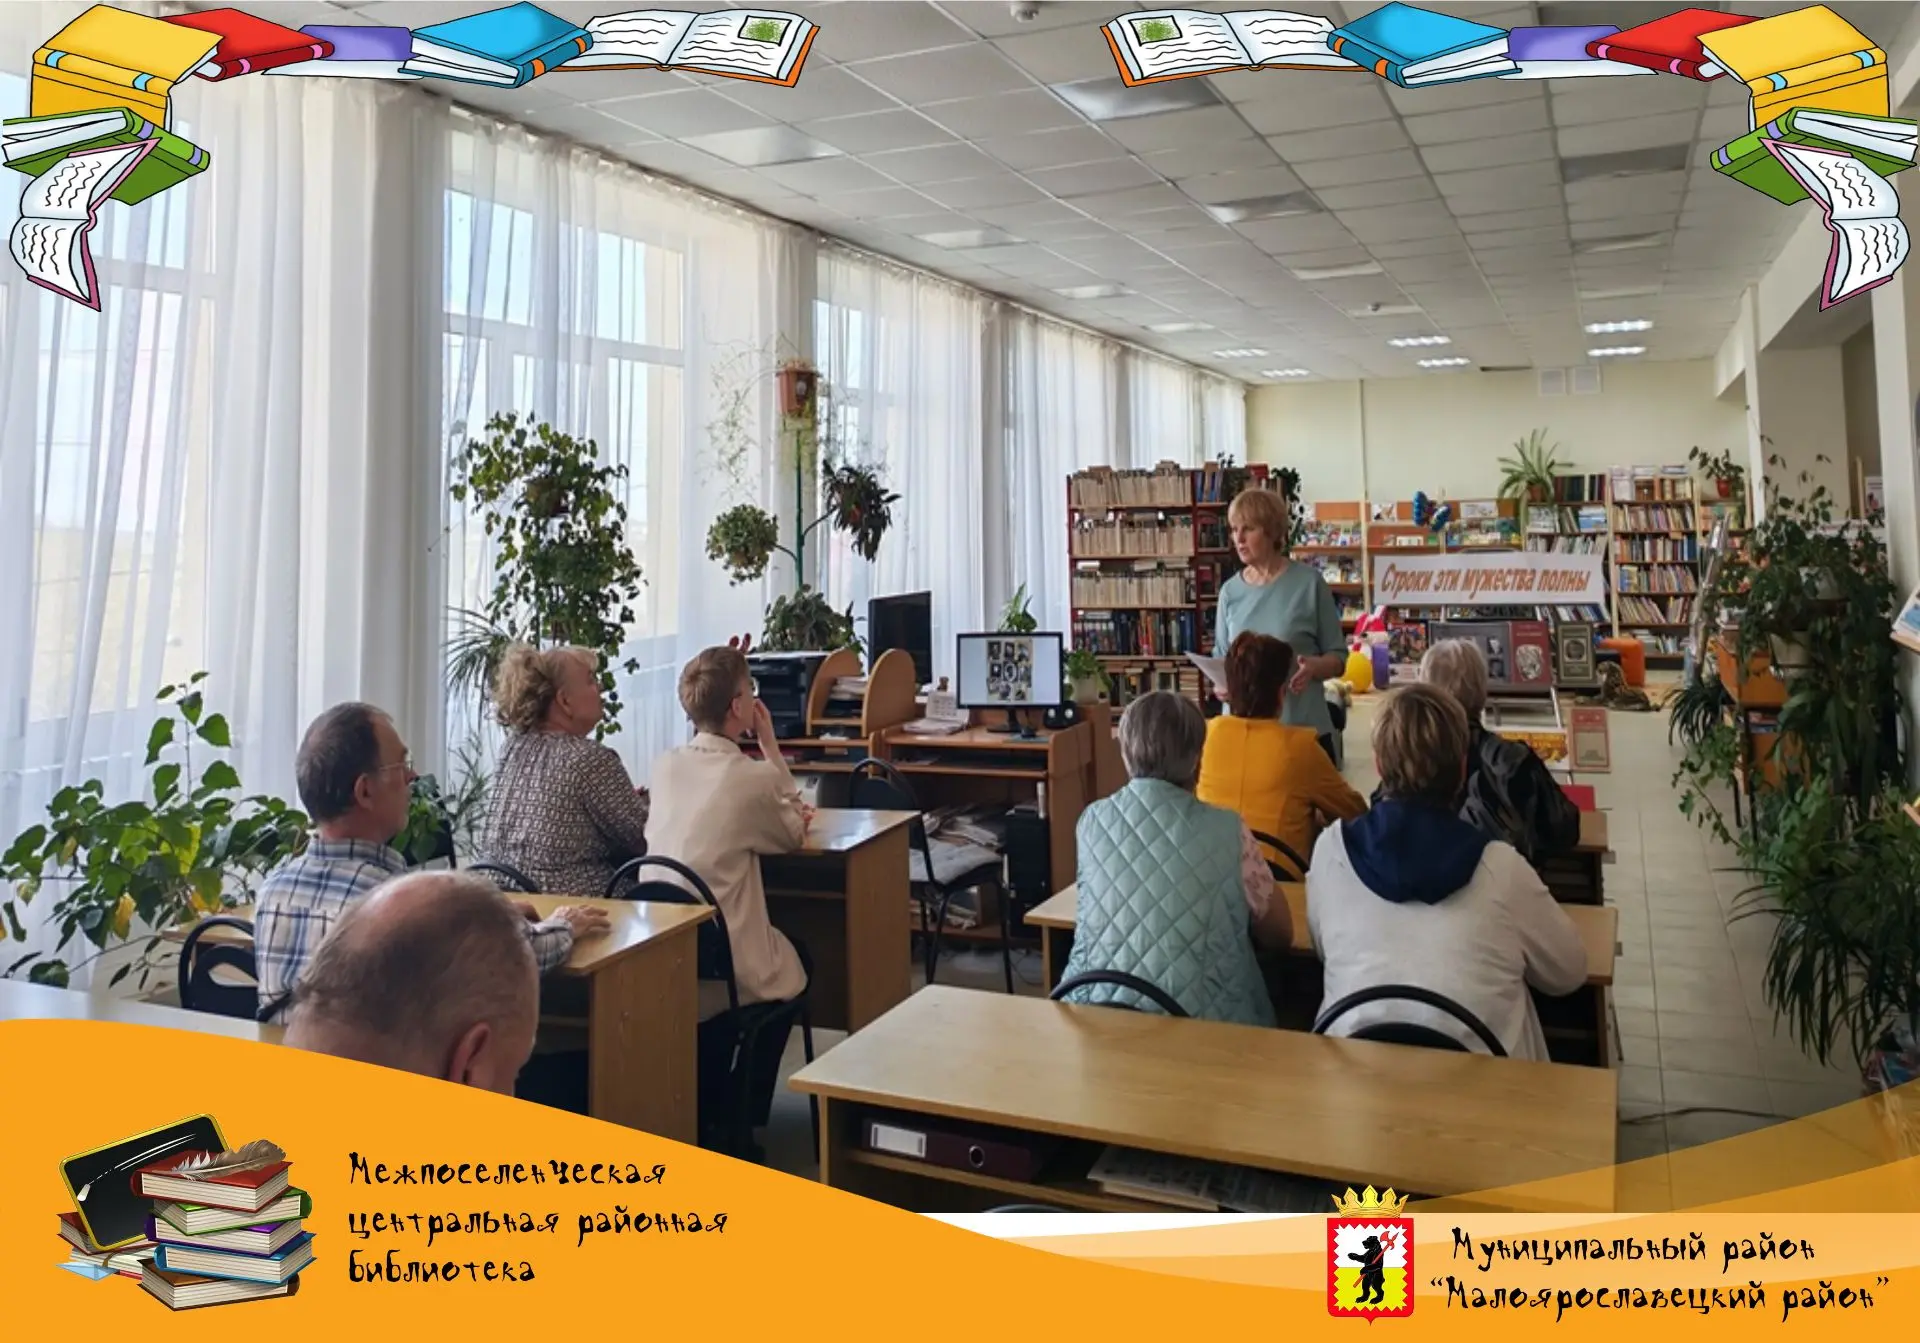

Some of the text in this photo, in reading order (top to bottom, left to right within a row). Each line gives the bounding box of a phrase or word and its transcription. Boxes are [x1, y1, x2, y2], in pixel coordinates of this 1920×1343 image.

[1381, 563, 1591, 599] Строки эти мужества полны
